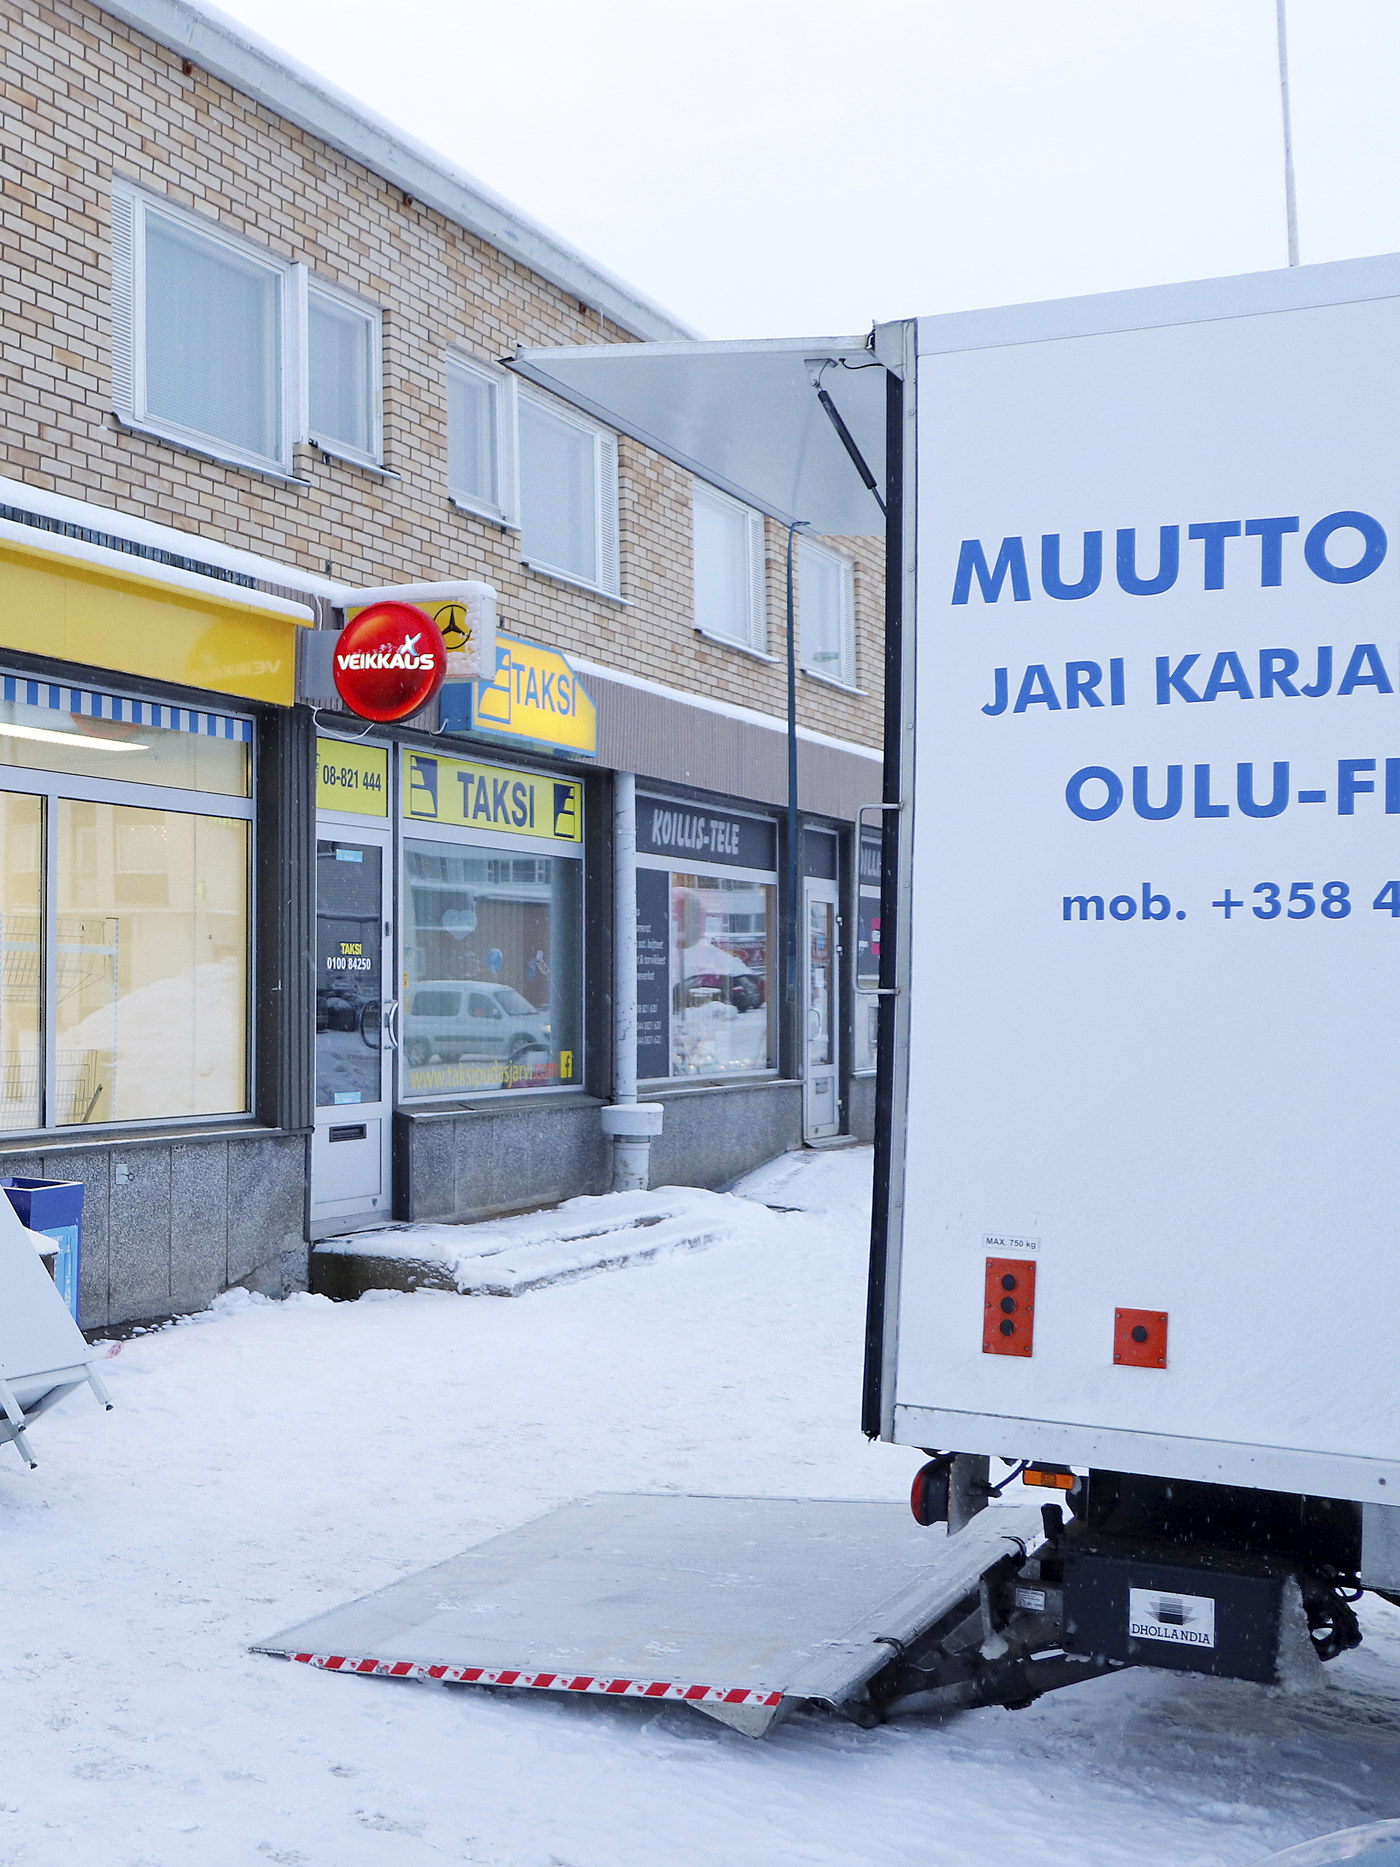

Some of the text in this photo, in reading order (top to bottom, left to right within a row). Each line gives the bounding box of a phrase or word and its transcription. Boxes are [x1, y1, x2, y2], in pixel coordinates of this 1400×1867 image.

[951, 510, 1388, 606] MUUTTO
[337, 653, 435, 670] VEIKKAUS
[512, 661, 576, 717] TAKSI
[981, 643, 1400, 717] JARI KARJA
[322, 764, 382, 791] 08-821 444
[456, 771, 535, 828] TAKSI
[652, 808, 740, 855] KOILLIS-TELE
[1062, 882, 1187, 921] mob.
[1212, 880, 1352, 920] +358
[326, 956, 372, 970] 0100 84250
[340, 942, 363, 955] TAKSI
[986, 1237, 1036, 1249] MAX. 750 kg
[1131, 1623, 1211, 1644] DHOLLANDIA
